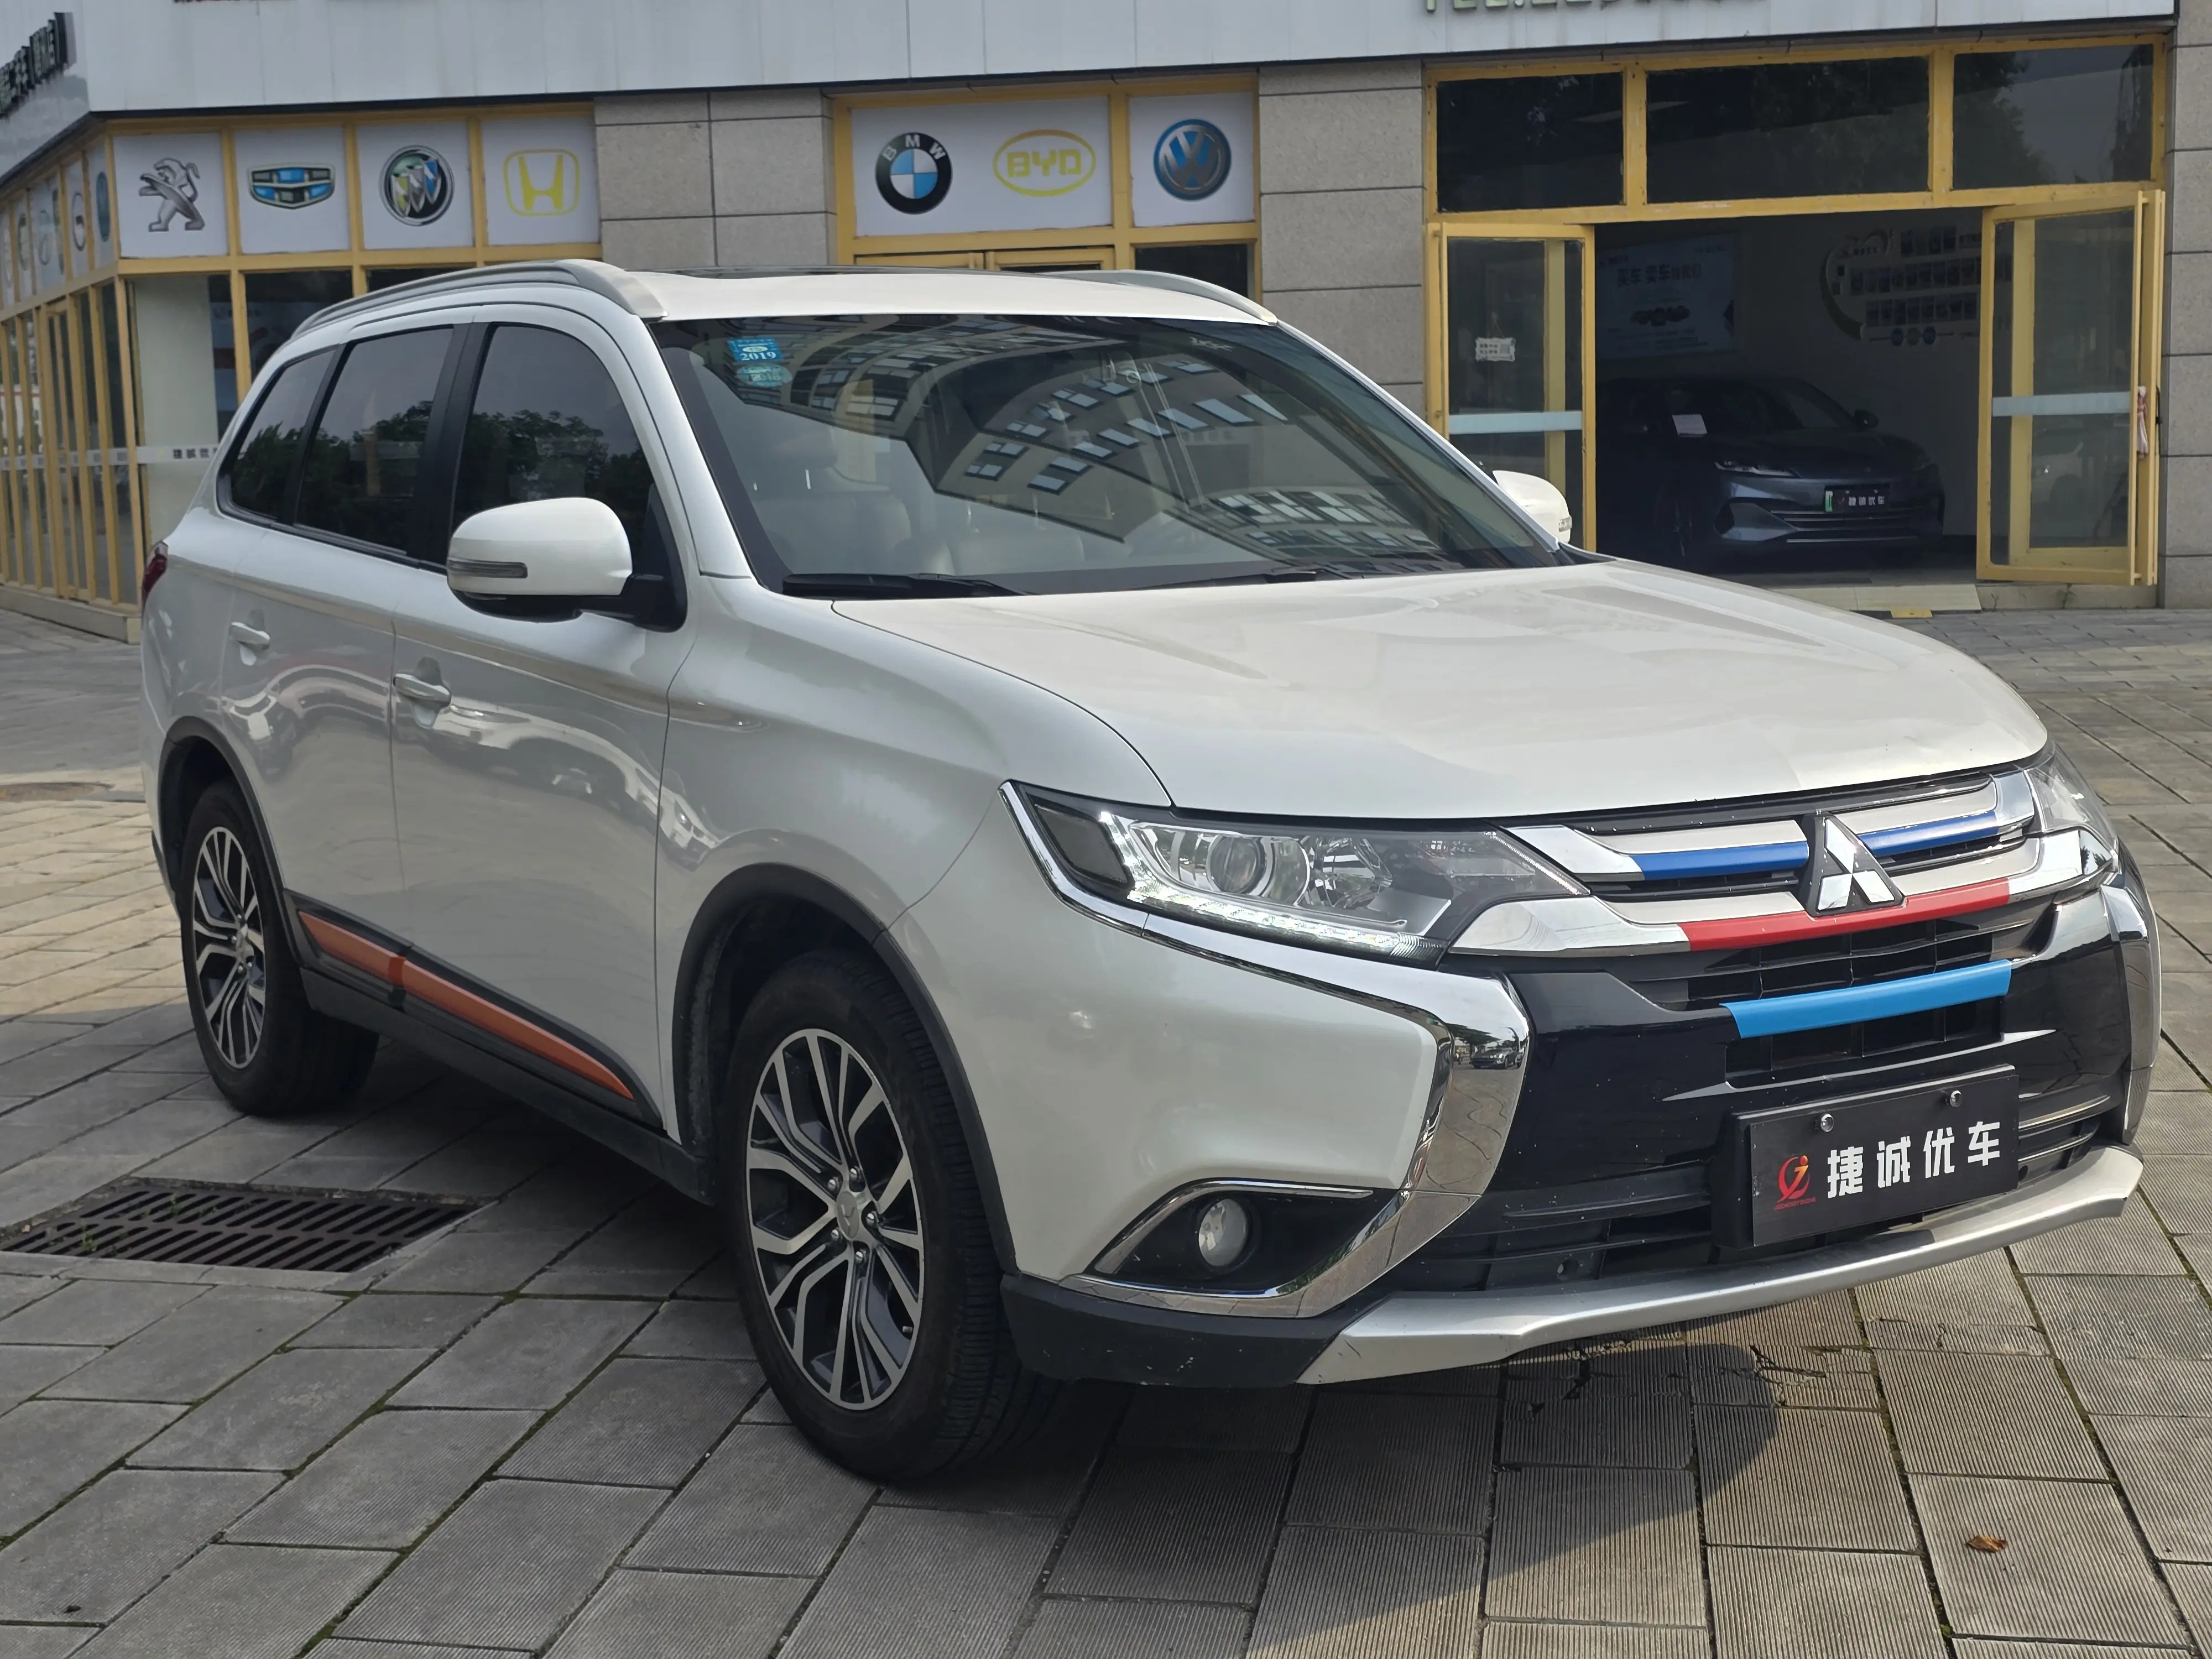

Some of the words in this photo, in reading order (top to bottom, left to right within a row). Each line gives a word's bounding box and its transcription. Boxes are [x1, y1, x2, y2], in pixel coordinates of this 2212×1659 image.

[883, 134, 945, 161] BMW
[1006, 148, 1082, 178] BYD
[739, 351, 777, 361] 2019
[1827, 1120, 2001, 1199] 捷诚优车
